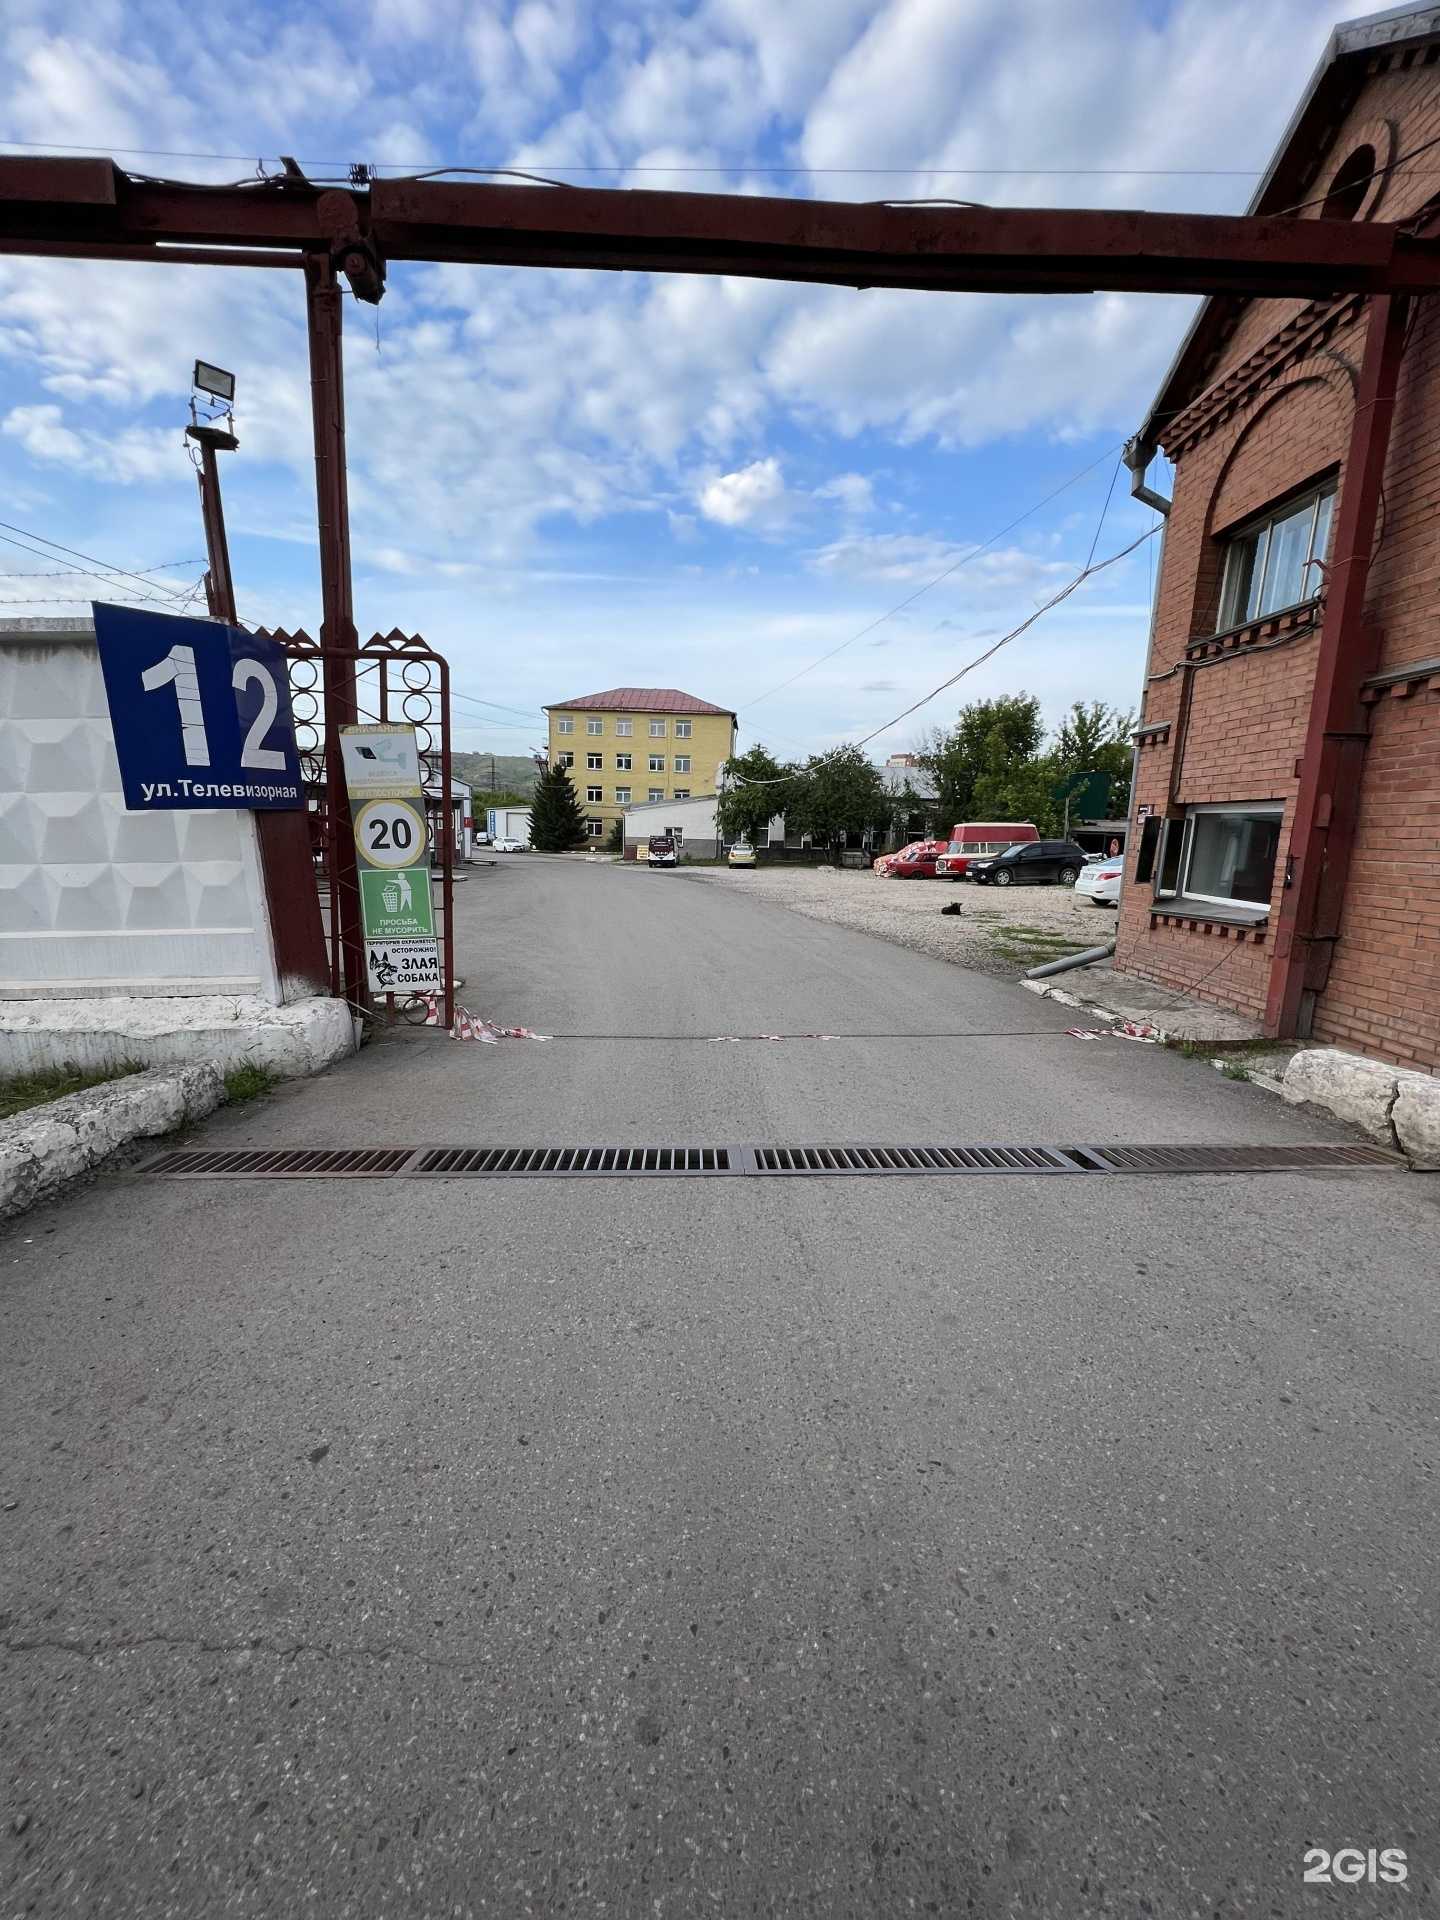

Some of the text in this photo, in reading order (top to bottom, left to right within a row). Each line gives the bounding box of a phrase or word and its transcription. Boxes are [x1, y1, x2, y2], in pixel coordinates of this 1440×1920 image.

[141, 644, 287, 771] 12
[141, 779, 298, 802] ул.Телевизорная
[368, 818, 413, 851] 20
[385, 926, 428, 935] МУСОРИТЬ
[401, 957, 438, 970] ЗЛАЯ
[397, 973, 439, 983] СОБАКА
